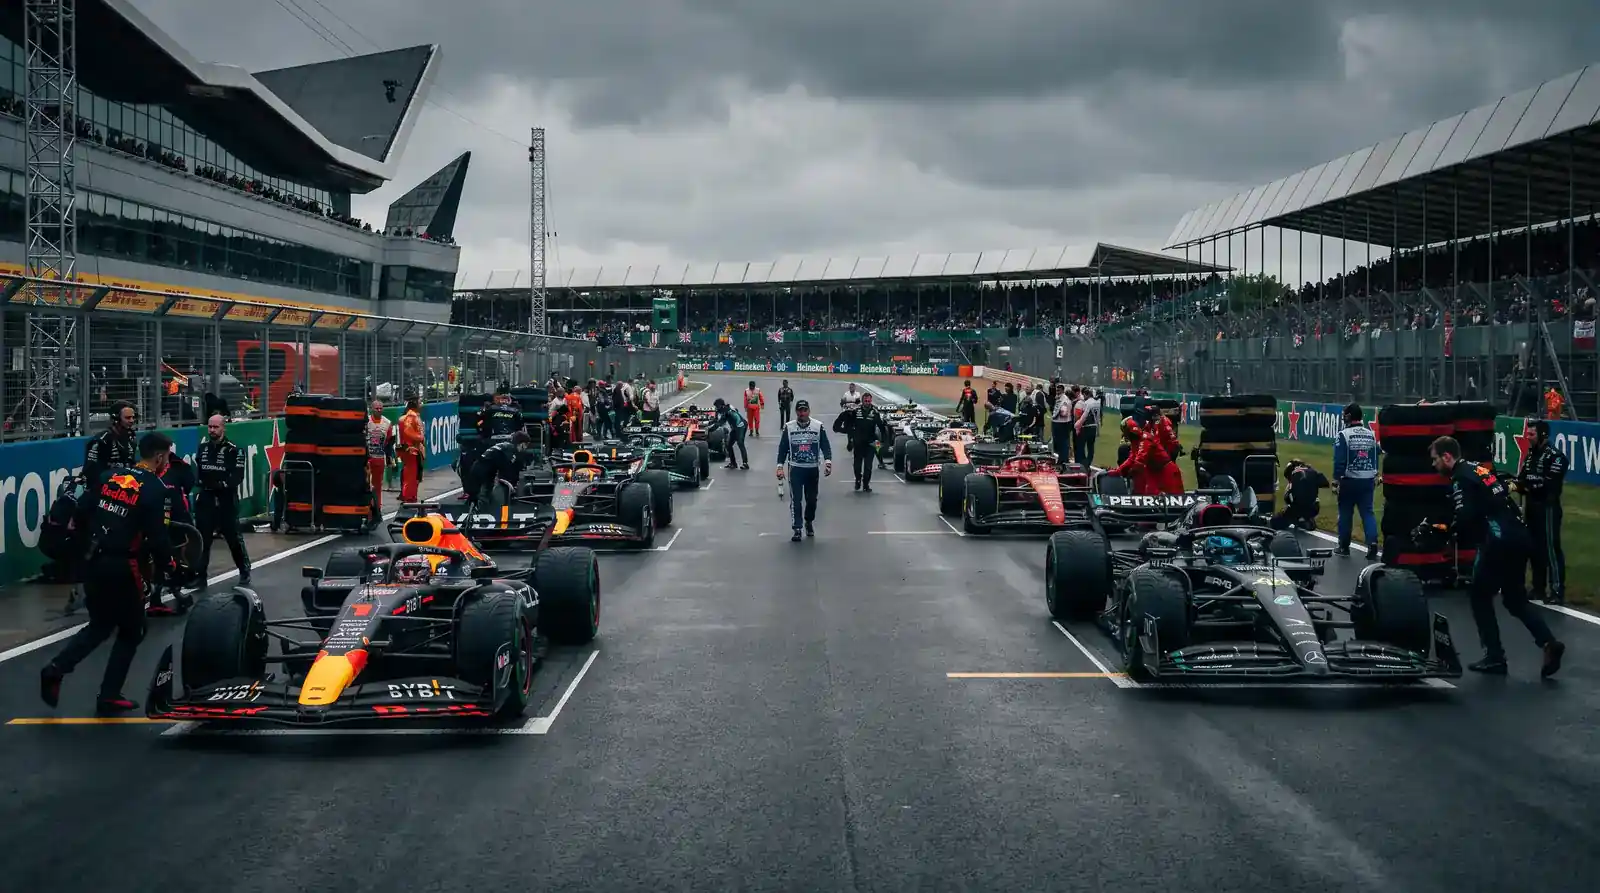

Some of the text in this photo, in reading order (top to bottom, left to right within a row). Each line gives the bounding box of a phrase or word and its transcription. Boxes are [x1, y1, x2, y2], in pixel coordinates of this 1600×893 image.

[734, 362, 765, 371] Heineken
[797, 362, 828, 372] Heineken
[860, 364, 891, 374] Heineken
[101, 483, 120, 500] Red
[98, 499, 119, 514] Mobil
[1213, 577, 1233, 590] AMG
